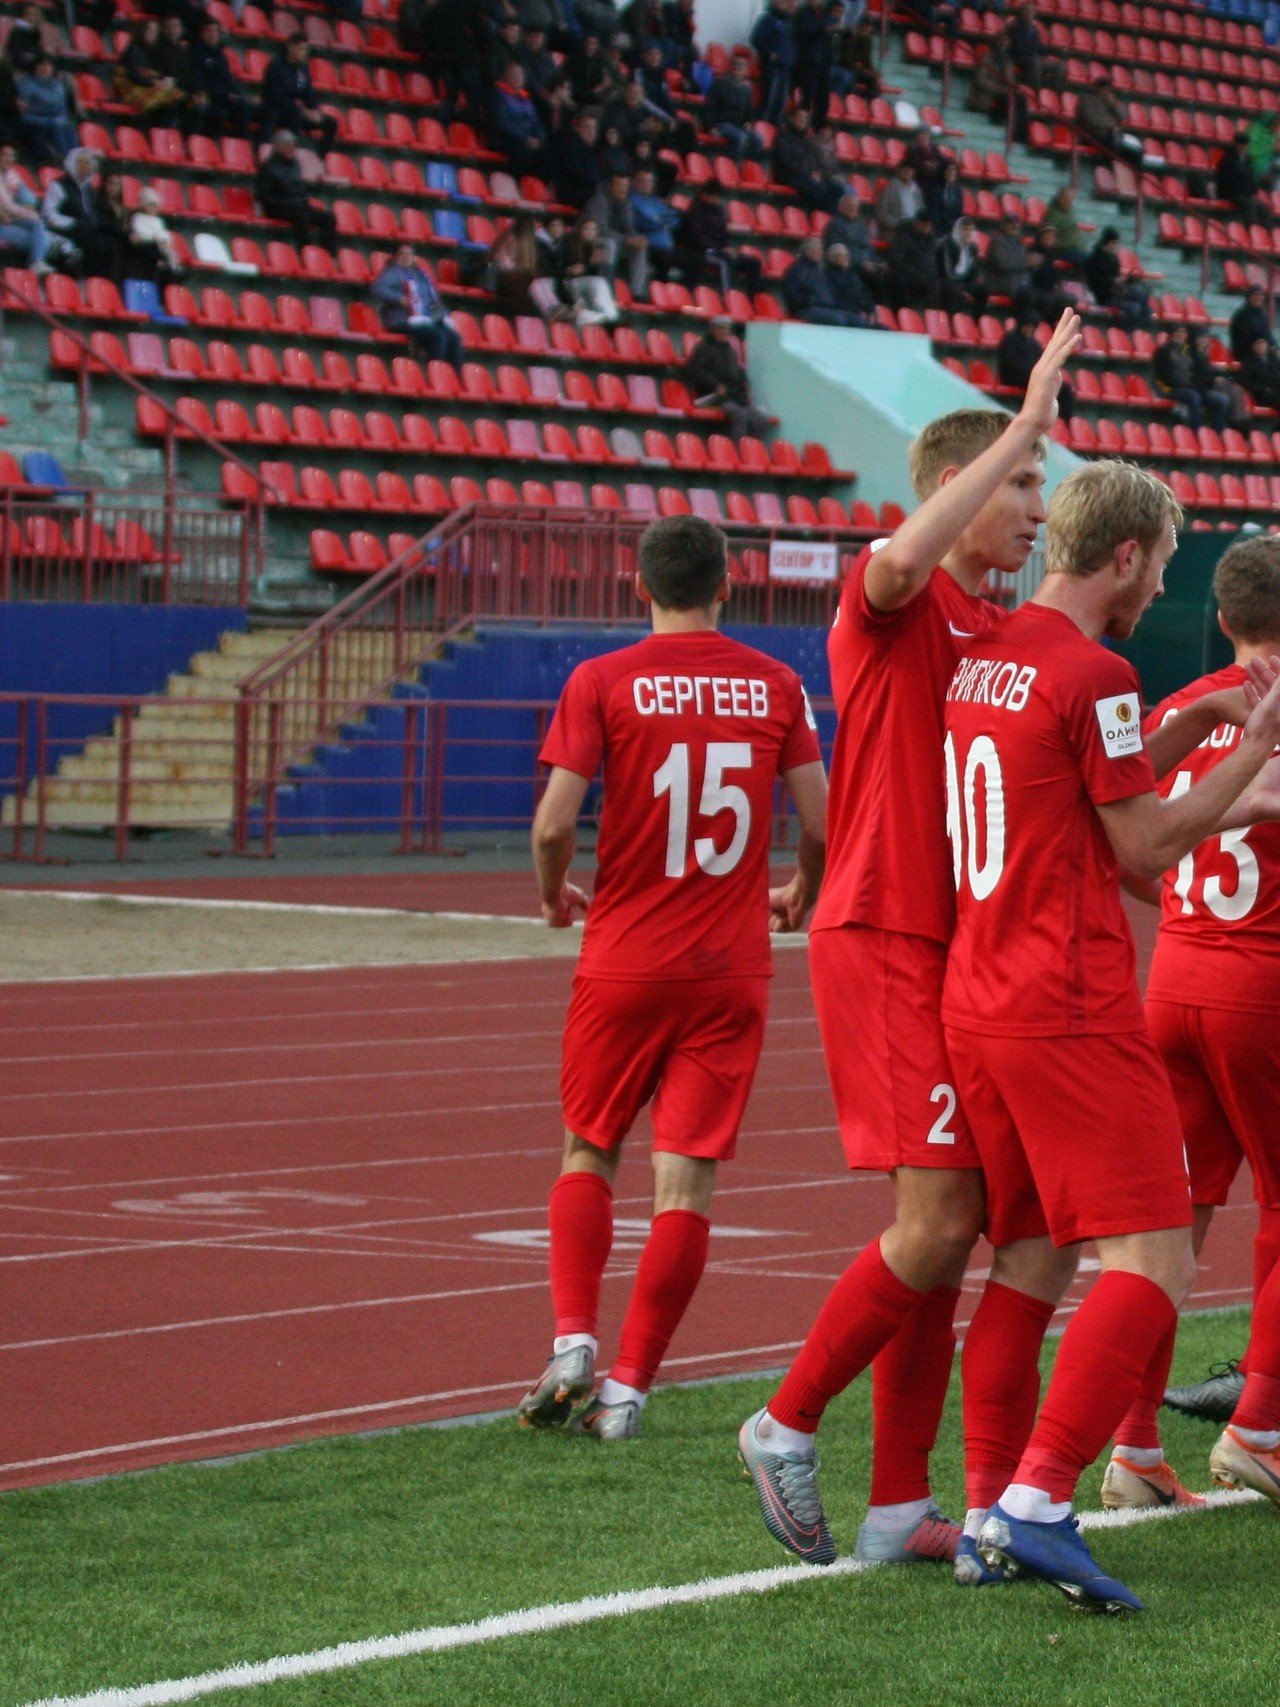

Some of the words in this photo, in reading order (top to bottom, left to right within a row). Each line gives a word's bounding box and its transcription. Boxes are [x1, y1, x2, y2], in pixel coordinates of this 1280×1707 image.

[633, 676, 769, 718] СЕРГЕЕВ
[653, 742, 752, 877] 15
[927, 1083, 956, 1145] 2
